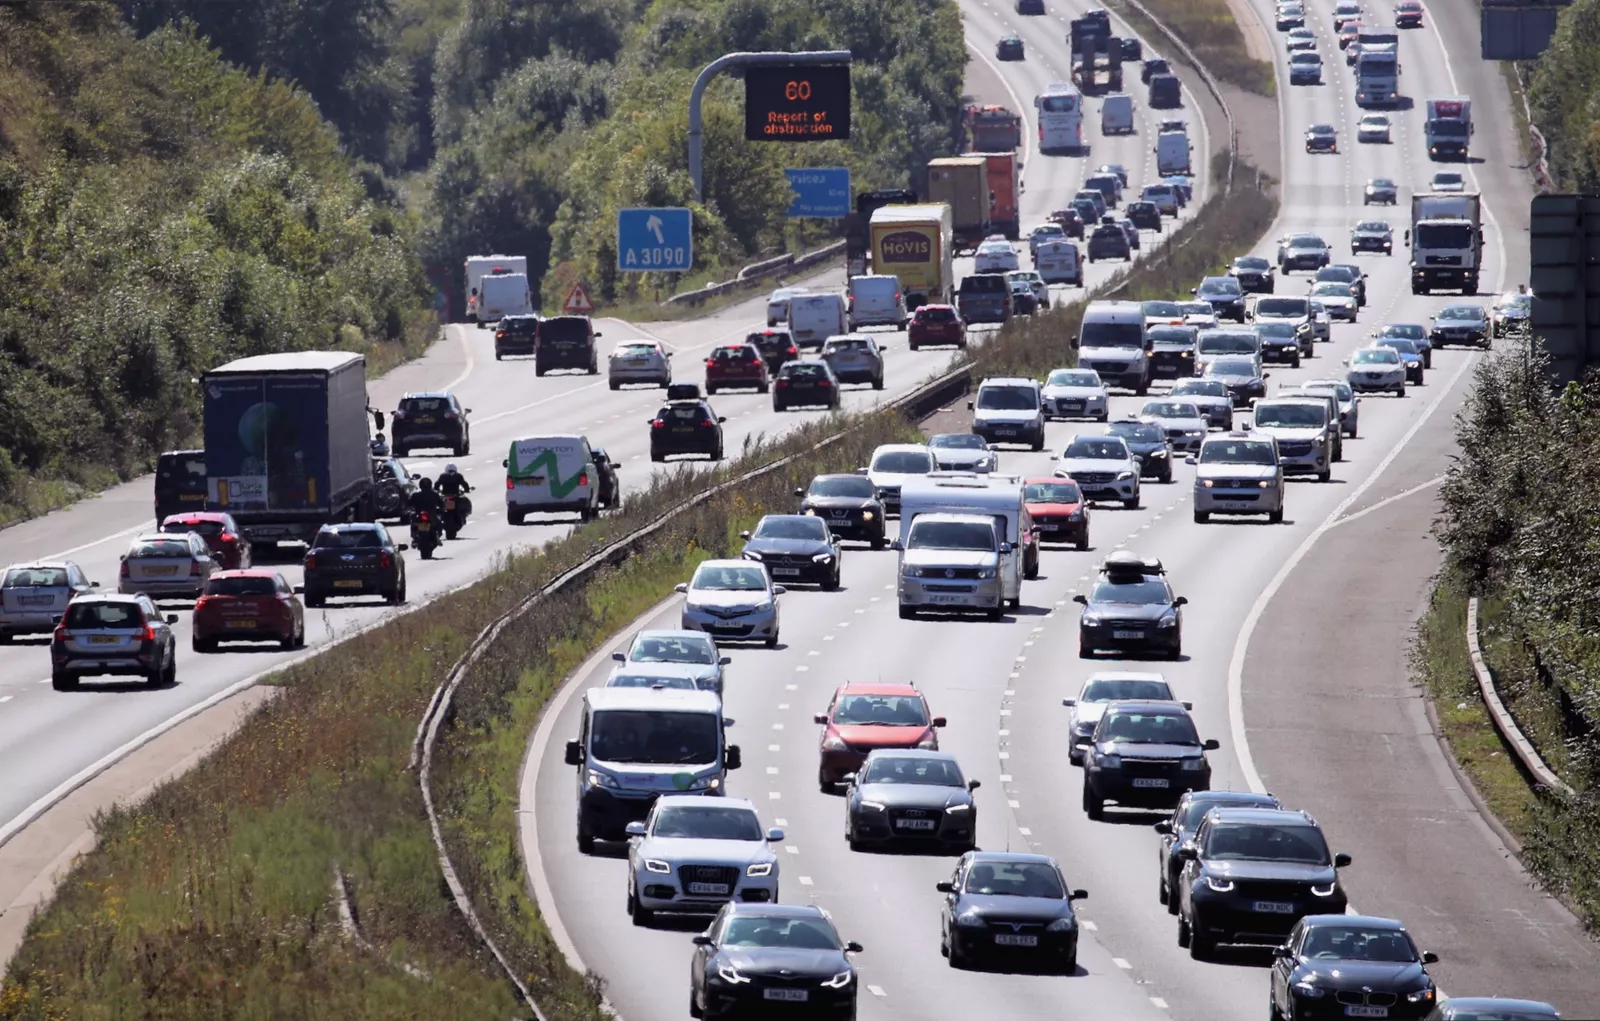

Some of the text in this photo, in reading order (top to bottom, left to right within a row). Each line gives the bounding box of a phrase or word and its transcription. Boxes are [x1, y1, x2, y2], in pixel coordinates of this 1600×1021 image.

[785, 80, 812, 101] 60
[768, 111, 827, 123] Report of
[763, 122, 833, 135] obstruction
[883, 241, 929, 255] HOVIS
[626, 247, 684, 265] A 3090
